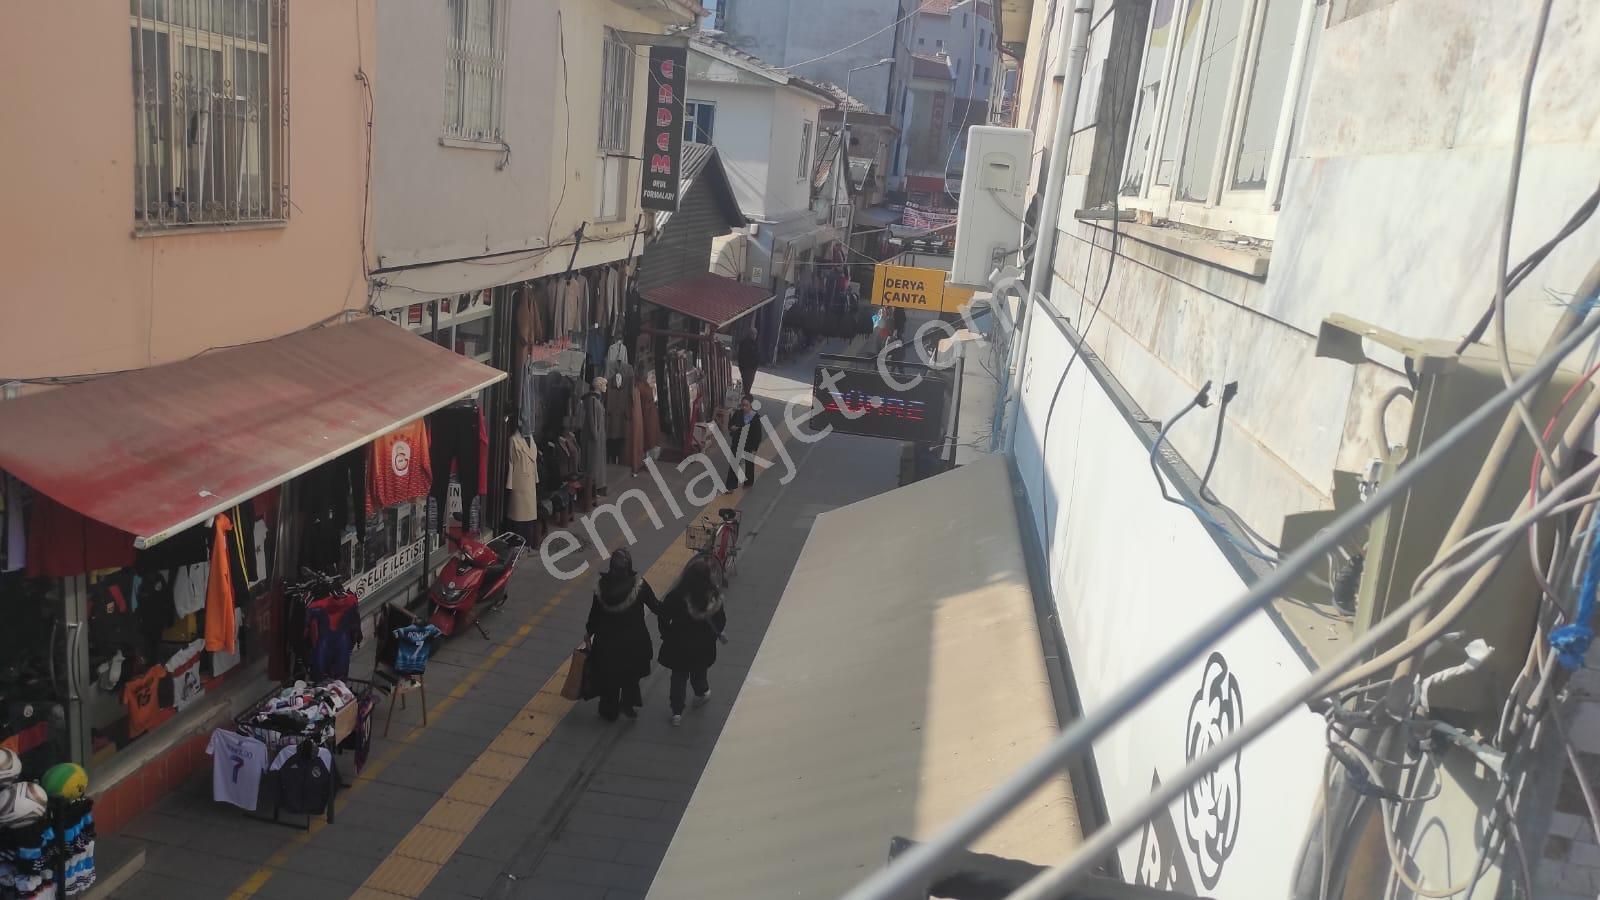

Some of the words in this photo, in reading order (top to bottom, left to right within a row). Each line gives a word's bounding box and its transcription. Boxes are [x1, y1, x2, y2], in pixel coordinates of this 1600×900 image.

[652, 180, 667, 189] OKUL
[885, 278, 925, 291] DERYA
[883, 291, 927, 305] ÇANTA
[411, 640, 425, 659] 7
[230, 755, 245, 785] 7
